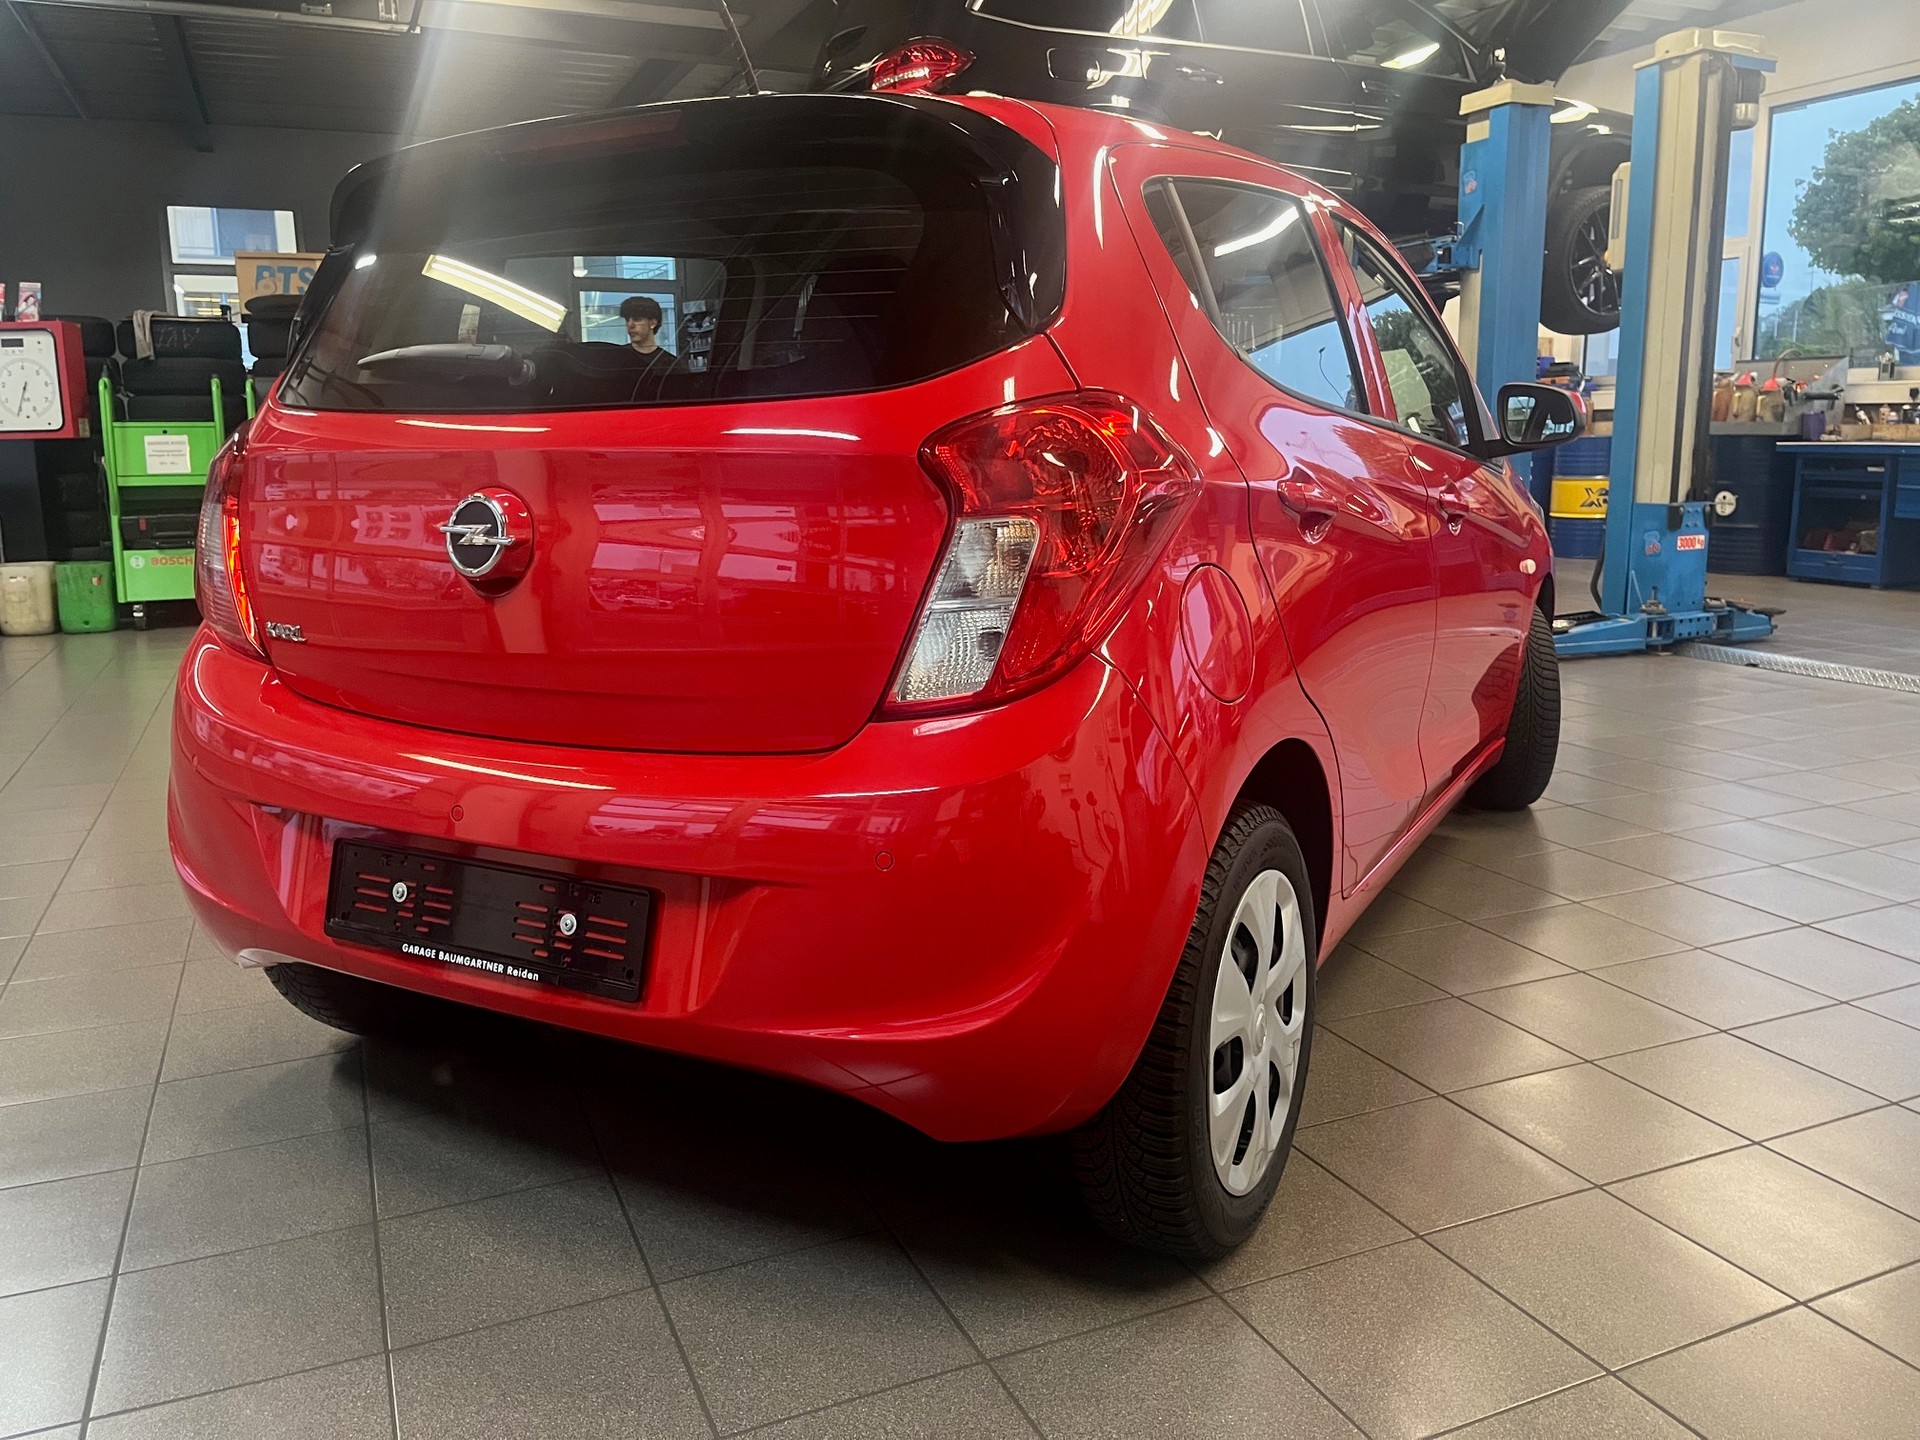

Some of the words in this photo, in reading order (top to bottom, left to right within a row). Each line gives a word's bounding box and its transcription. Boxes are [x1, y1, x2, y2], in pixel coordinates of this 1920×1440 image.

[1679, 537, 1697, 549] 3000
[150, 556, 193, 566] BOSCH
[266, 621, 307, 641] KARL
[402, 943, 436, 959] GARAGE
[438, 951, 504, 974] BAUMGARTNER
[507, 965, 539, 981] Reiden
